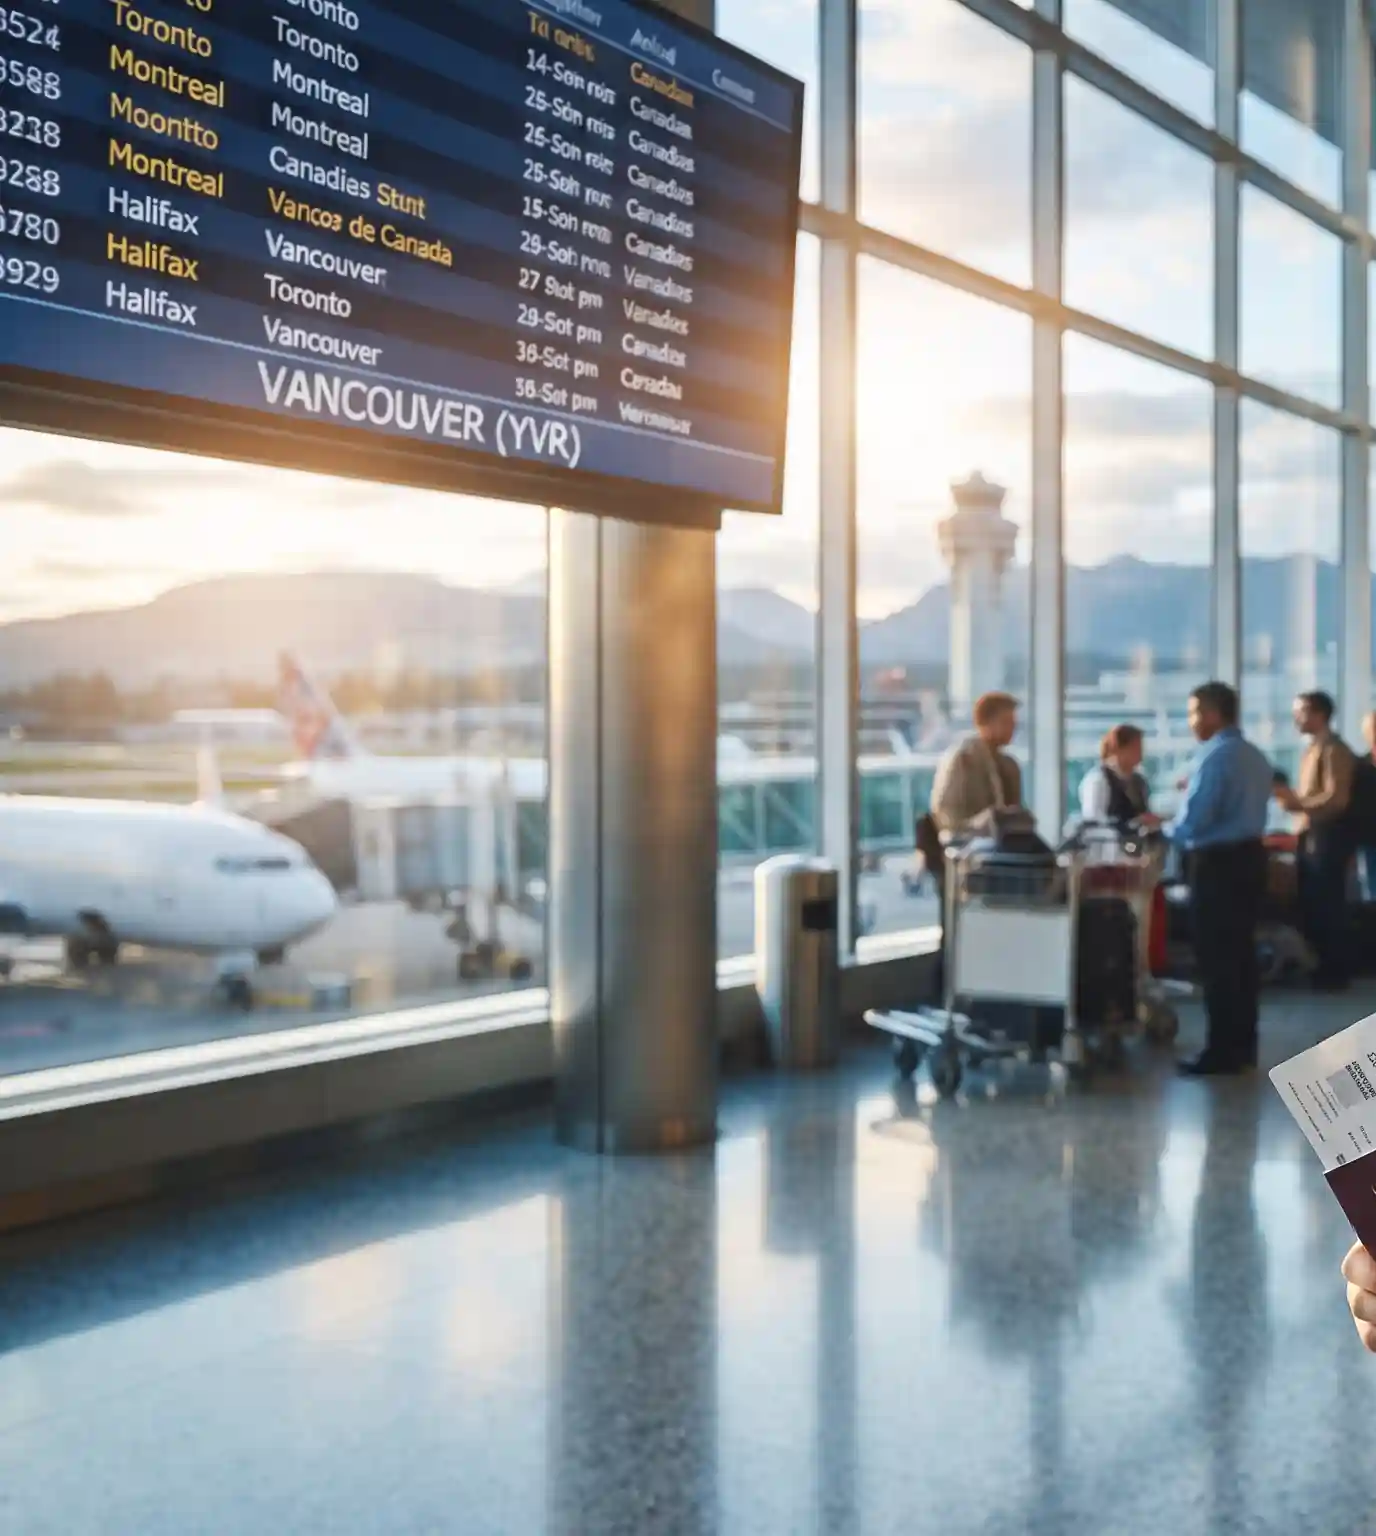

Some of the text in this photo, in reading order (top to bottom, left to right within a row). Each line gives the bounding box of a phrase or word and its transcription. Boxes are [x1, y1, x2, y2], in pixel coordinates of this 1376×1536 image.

[109, 0, 212, 57] Toronto
[272, 15, 359, 72] Toronto
[109, 44, 224, 108] Montreal
[272, 58, 369, 118] Montreal
[110, 92, 218, 150] Moontto
[272, 101, 368, 160] Montreal
[109, 138, 223, 198] Montreal
[269, 146, 370, 199] Canadies
[108, 186, 199, 236] Halifax
[107, 232, 199, 281] Halifax
[265, 229, 387, 285] Vancouver
[349, 215, 375, 243] de
[380, 225, 453, 267] Canada
[264, 273, 352, 318] Toronto
[262, 315, 383, 365] Vancouver
[257, 360, 486, 443] VANCOUVER
[496, 409, 581, 469] (YVR)
